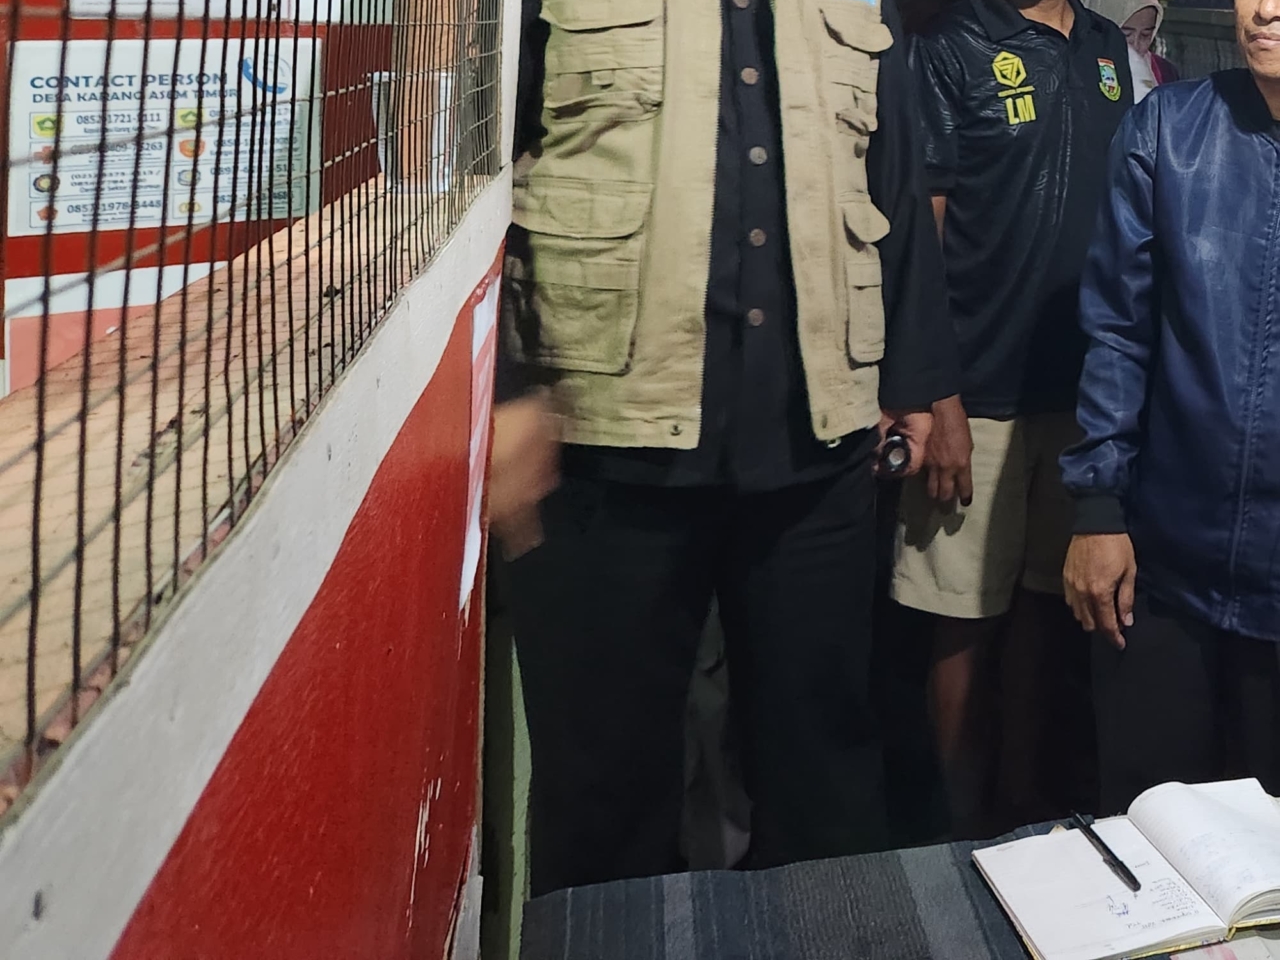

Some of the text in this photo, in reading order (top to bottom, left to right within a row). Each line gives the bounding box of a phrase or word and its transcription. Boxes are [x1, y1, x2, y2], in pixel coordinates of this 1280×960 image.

[29, 71, 228, 90] CONTACT PERSON
[1005, 94, 1037, 126] LM
